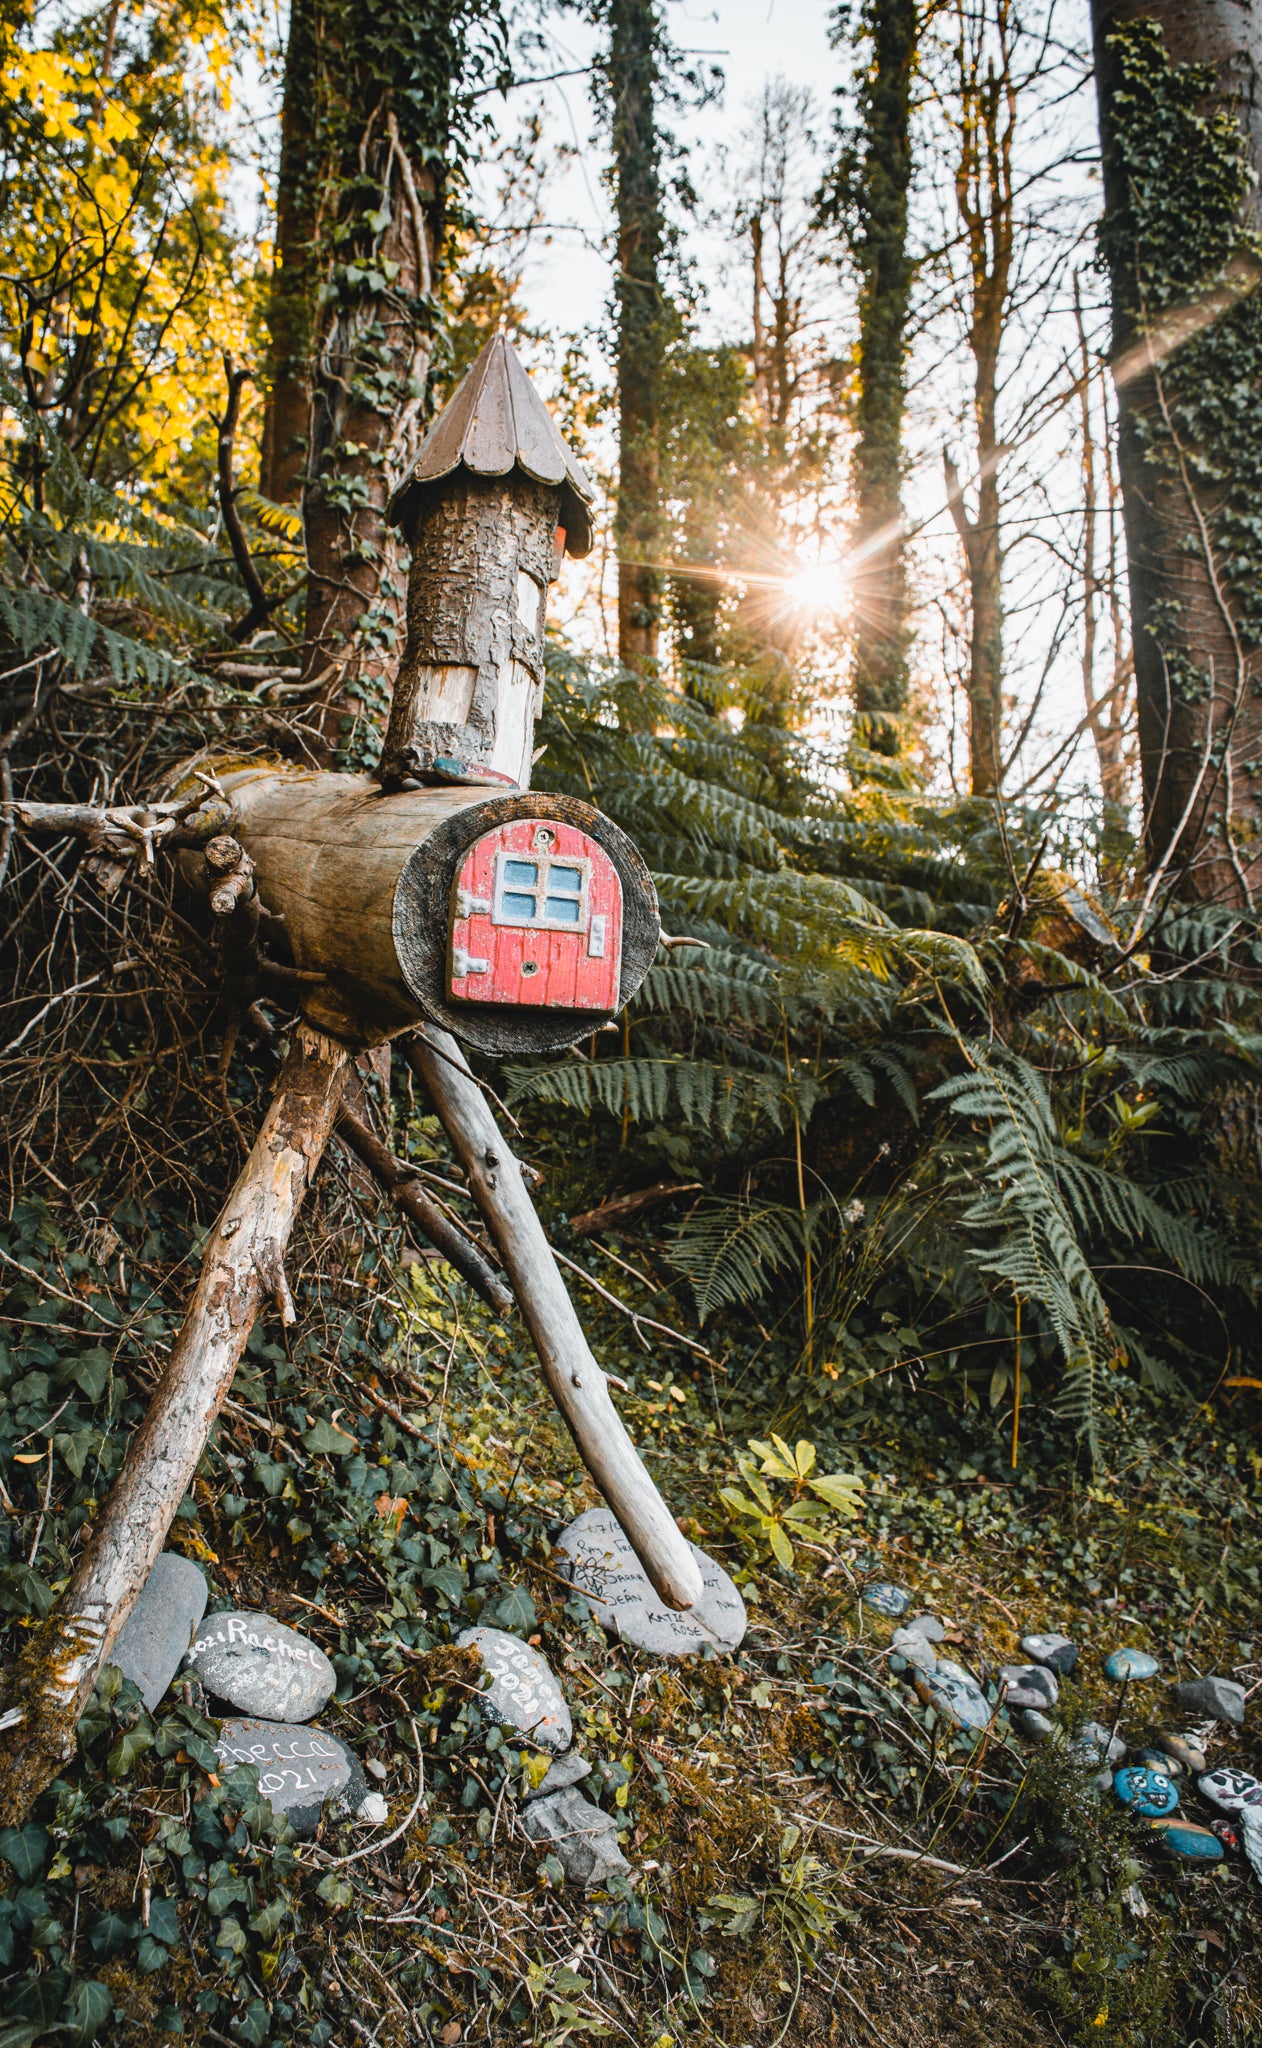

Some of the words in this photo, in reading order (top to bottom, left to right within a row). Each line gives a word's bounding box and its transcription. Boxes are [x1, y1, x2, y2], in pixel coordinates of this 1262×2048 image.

[645, 1611, 686, 1624] KATIE
[671, 1623, 703, 1636] ROSE
[227, 1618, 323, 1671] Rachel
[486, 1659, 540, 1714] 2021
